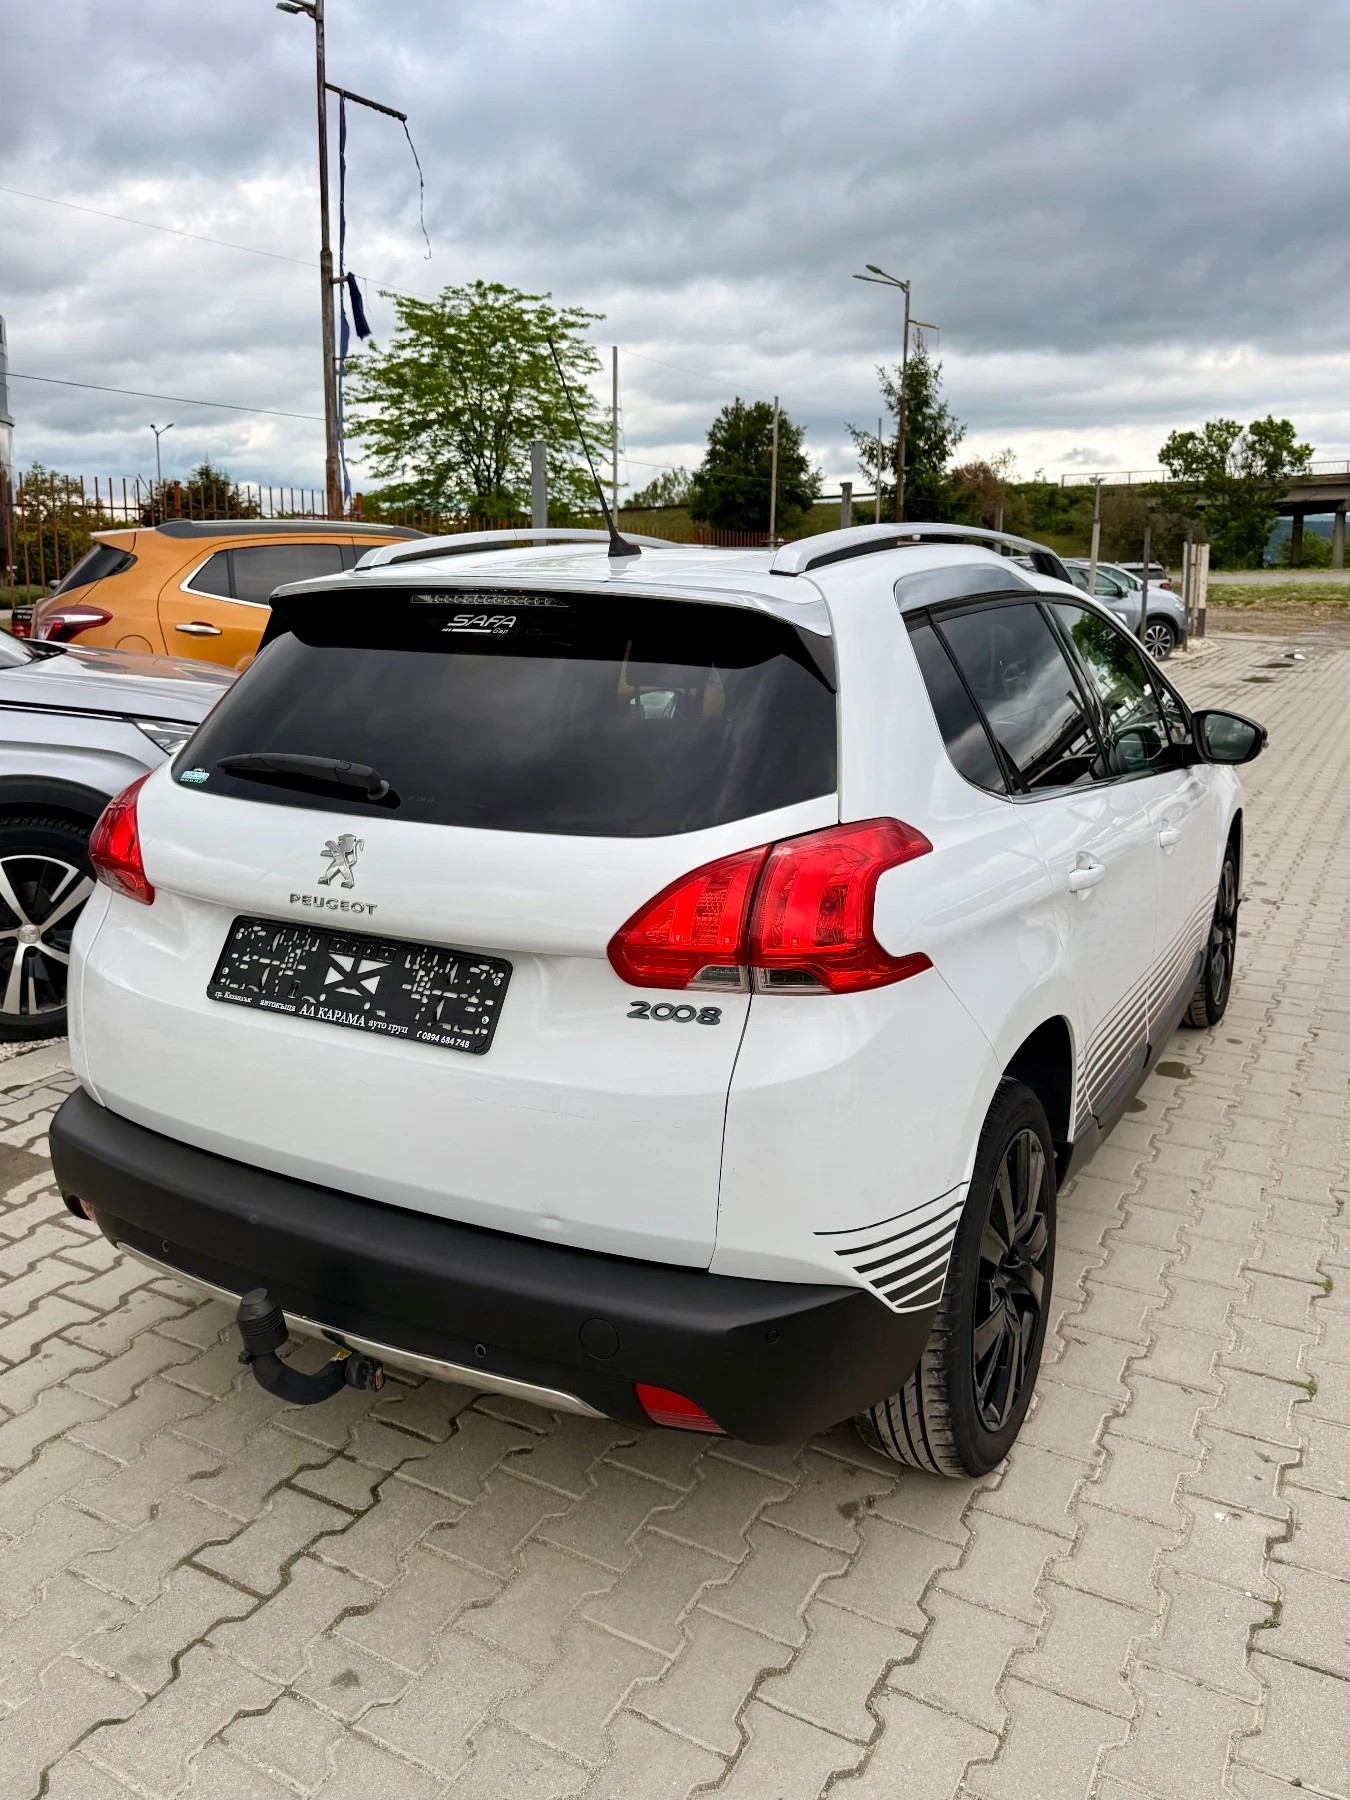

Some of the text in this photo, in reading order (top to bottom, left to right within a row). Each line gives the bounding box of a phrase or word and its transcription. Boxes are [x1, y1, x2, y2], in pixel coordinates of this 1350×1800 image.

[447, 614, 517, 628] SAFA
[289, 893, 378, 915] PEUGEOT
[260, 999, 296, 1012] автокъща
[299, 1003, 316, 1017] АЛ
[316, 1006, 366, 1027] КАРАМА
[368, 1019, 387, 1030] ауто
[387, 1023, 409, 1035] груп
[421, 1032, 441, 1043] 0894
[440, 1035, 455, 1046] 684
[454, 1038, 470, 1049] 748
[626, 1000, 723, 1026] 2008
